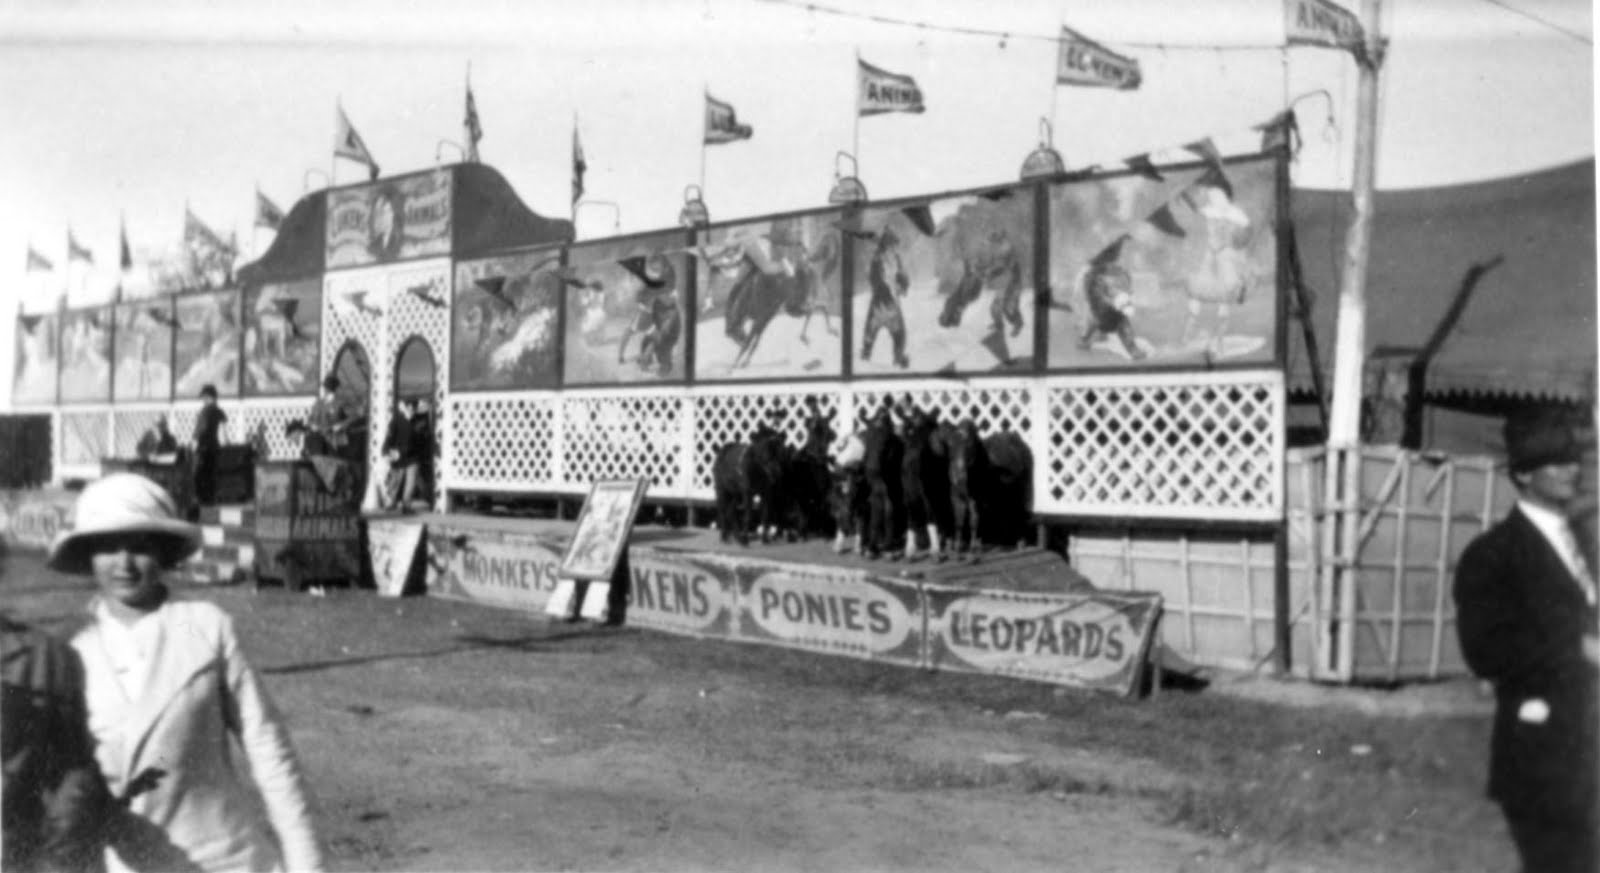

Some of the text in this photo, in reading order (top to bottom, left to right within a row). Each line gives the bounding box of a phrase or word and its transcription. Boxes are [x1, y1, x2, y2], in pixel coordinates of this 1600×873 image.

[462, 551, 558, 593] MONKEYS
[627, 566, 710, 618] KENS
[760, 587, 893, 635] PONIES
[950, 610, 1125, 662] LEOPARDS
